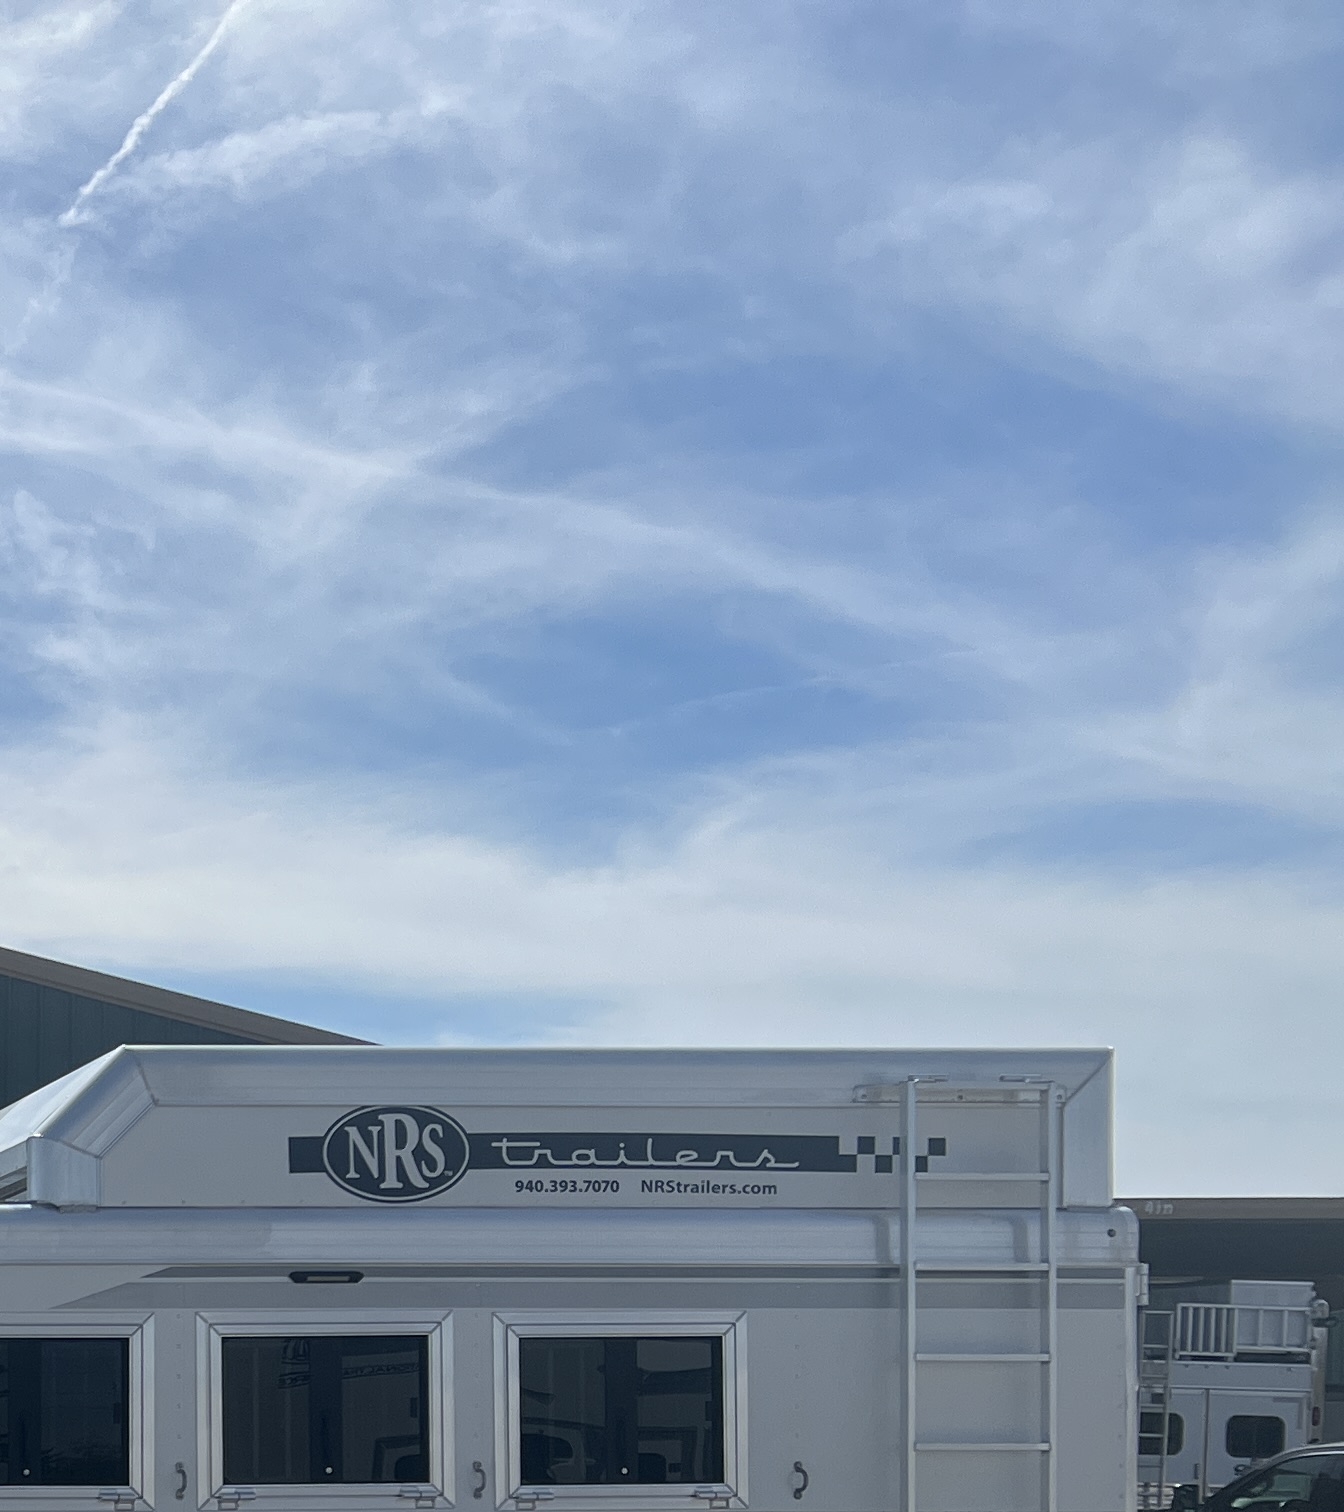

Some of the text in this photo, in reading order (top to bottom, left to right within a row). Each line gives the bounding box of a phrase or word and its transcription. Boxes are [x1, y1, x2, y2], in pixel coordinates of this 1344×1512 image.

[344, 1113, 446, 1189] NRS
[491, 1137, 800, 1168] trailers
[515, 1179, 778, 1195] 940.393.7070 NRStrailers.com
